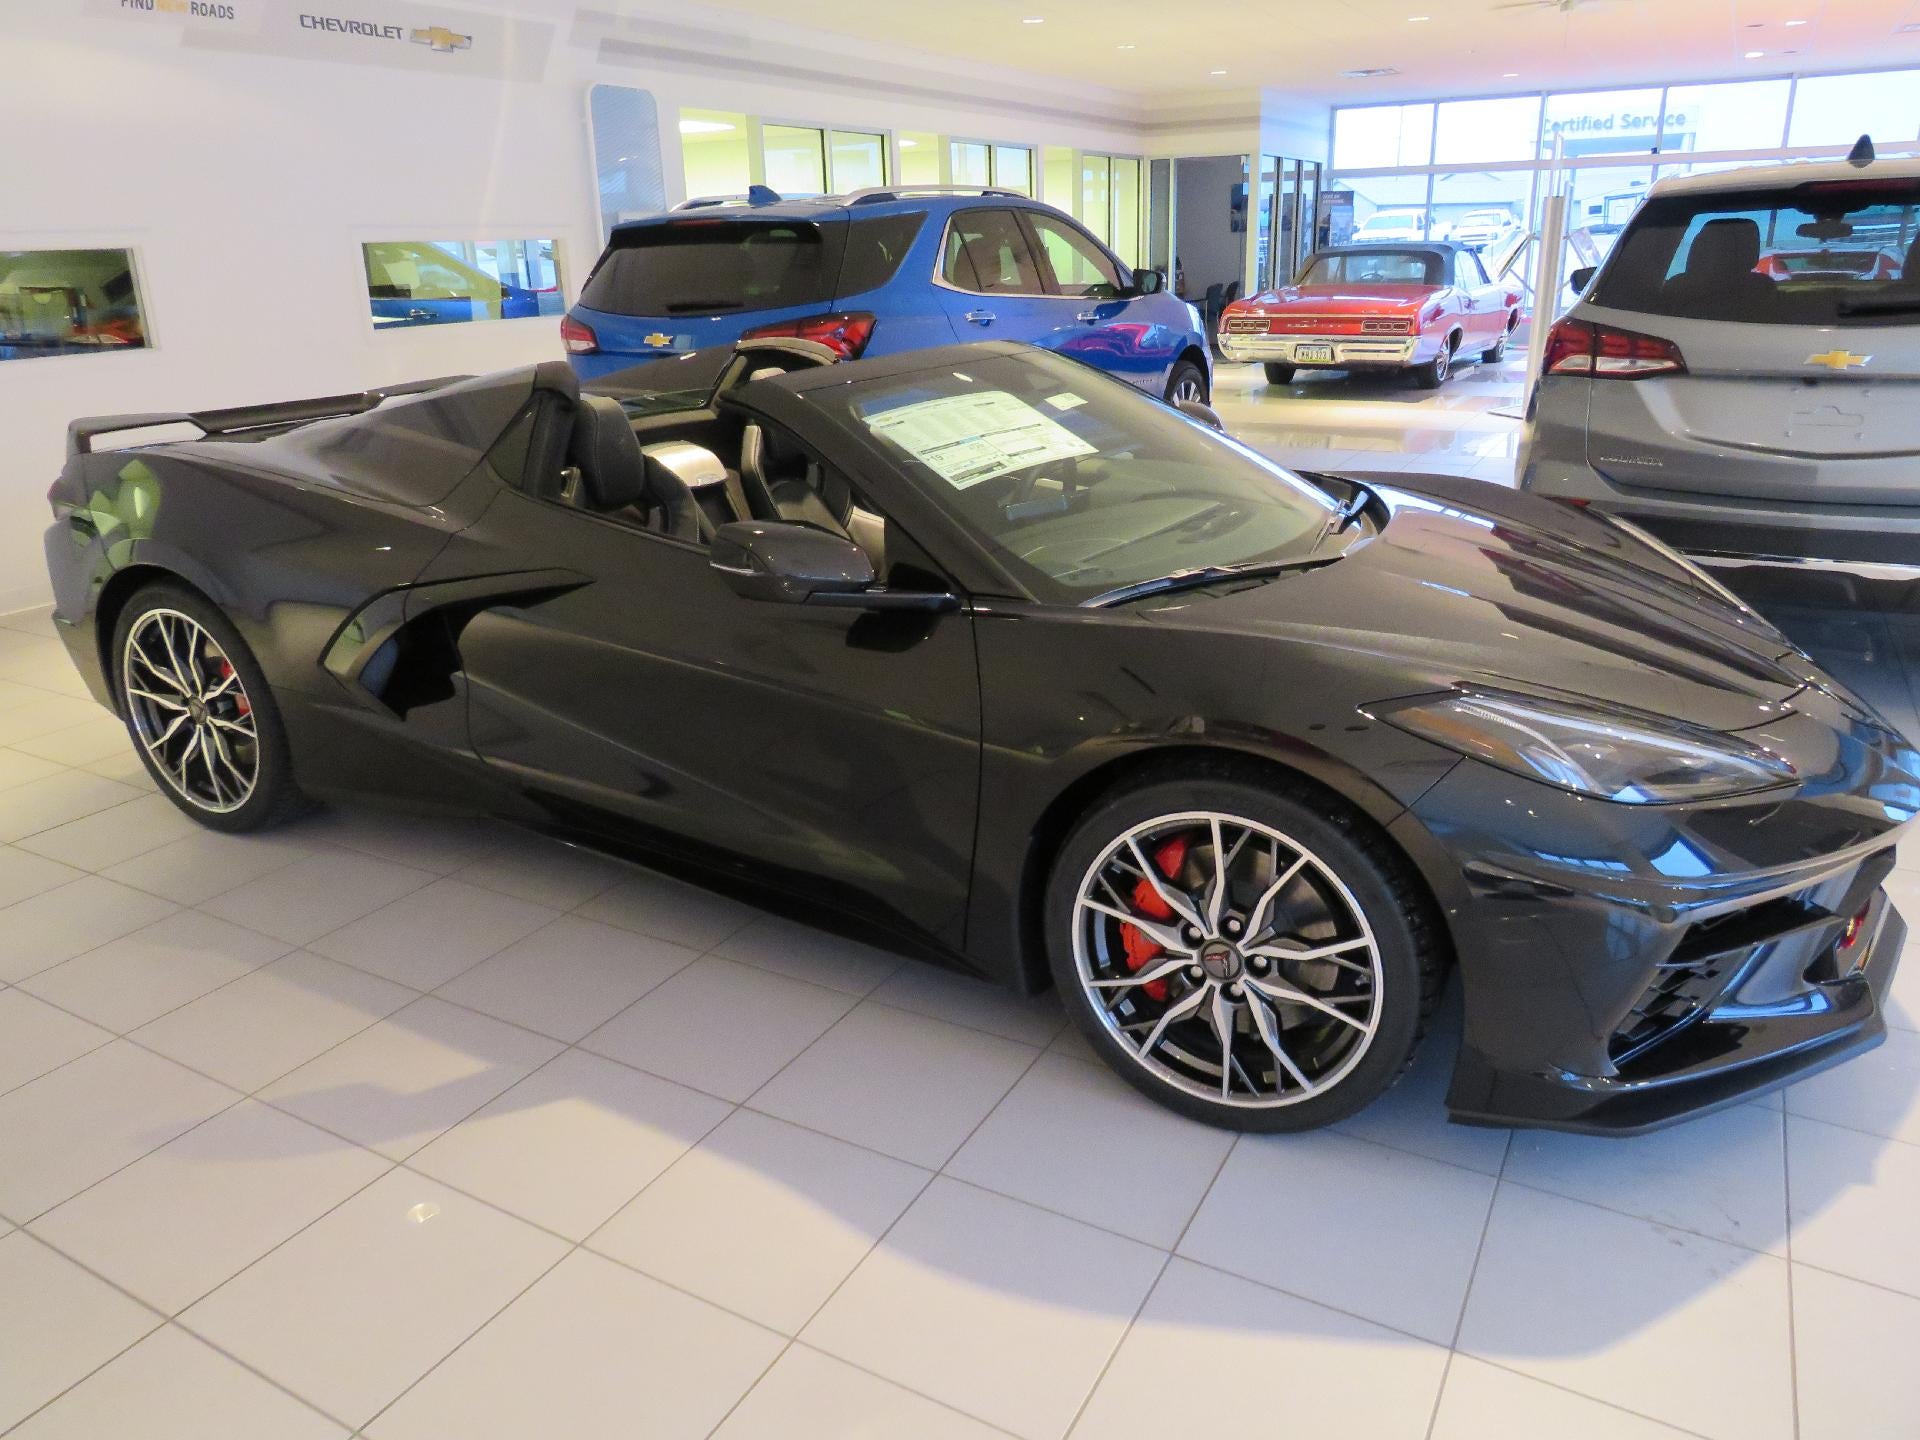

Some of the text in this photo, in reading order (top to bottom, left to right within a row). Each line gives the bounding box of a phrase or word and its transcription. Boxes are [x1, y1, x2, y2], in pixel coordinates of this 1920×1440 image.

[190, 1, 235, 20] ROADS
[299, 13, 404, 41] CHEVROLET
[1620, 113, 1686, 130] Servce
